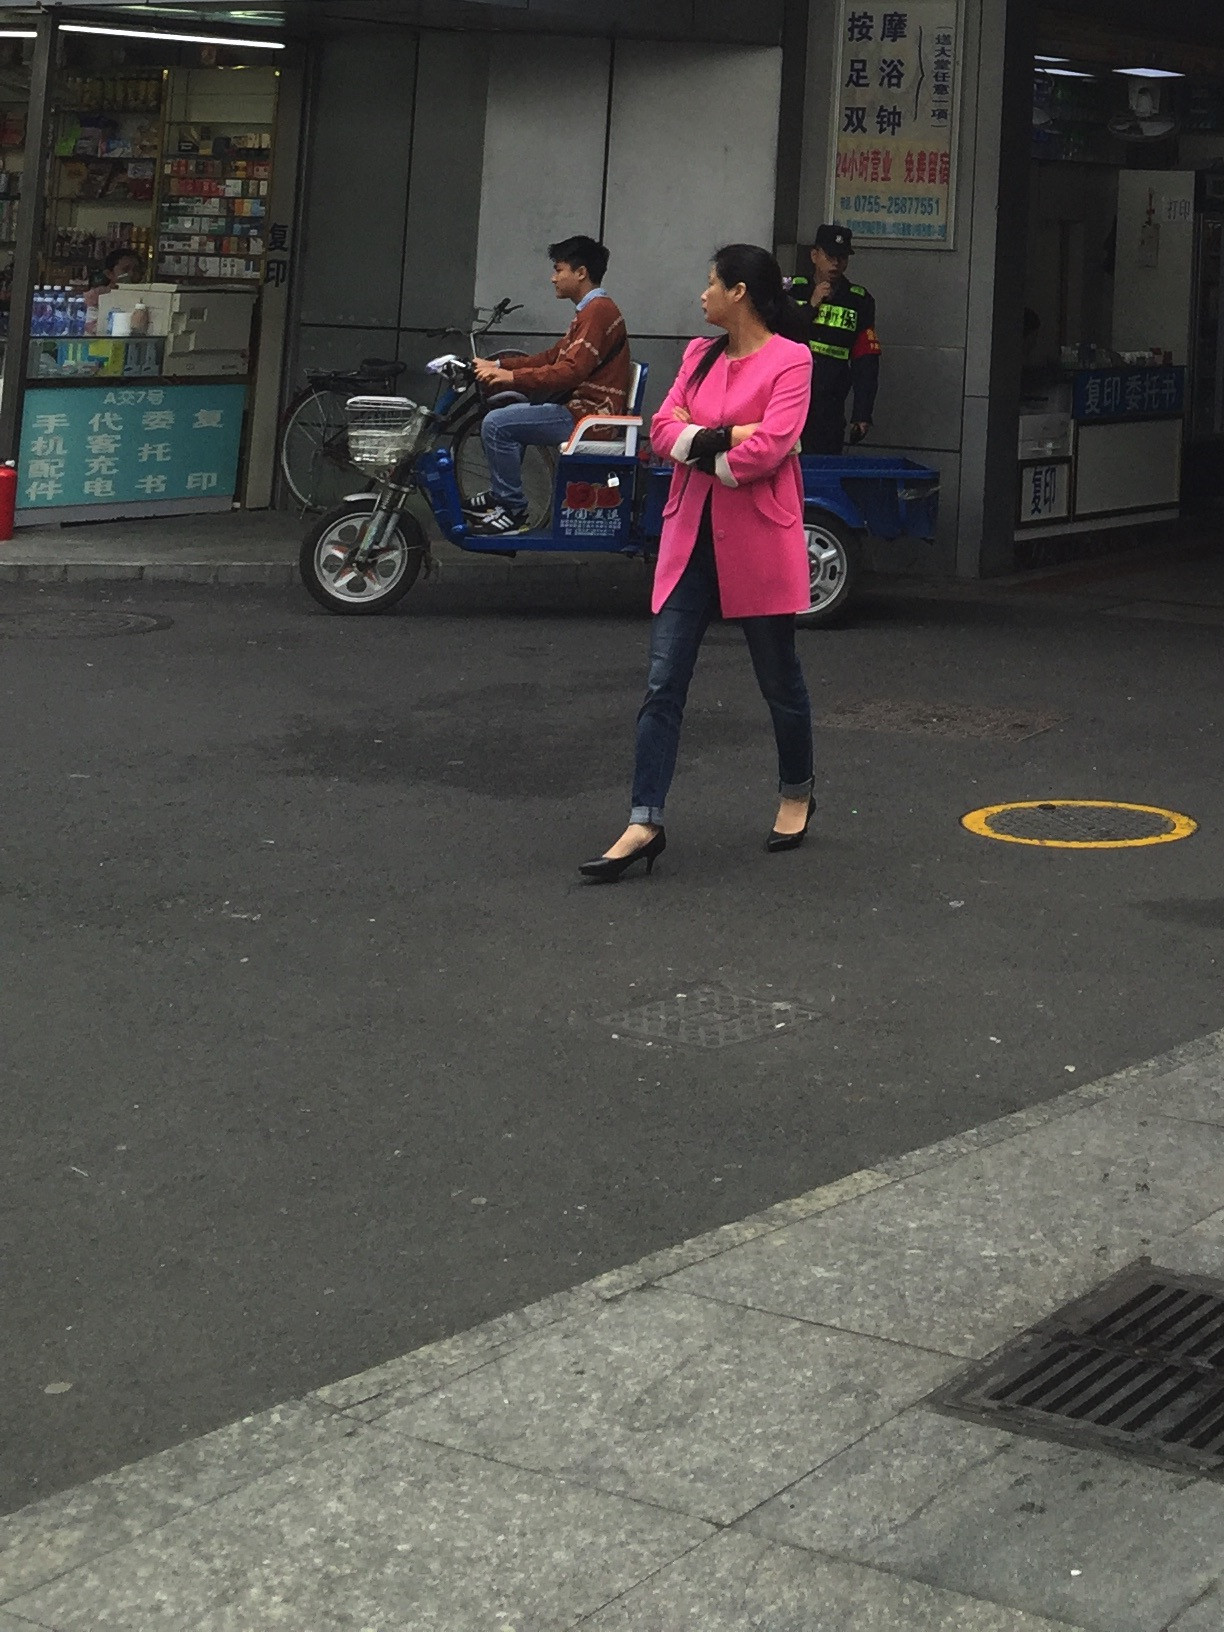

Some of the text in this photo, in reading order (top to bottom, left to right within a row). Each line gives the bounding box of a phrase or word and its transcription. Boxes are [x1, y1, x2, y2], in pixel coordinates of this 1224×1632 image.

[847, 11, 908, 43] 按摩
[845, 58, 905, 90] 足浴
[842, 104, 903, 136] 双钟
[853, 195, 940, 217] 0755-25877551
[264, 222, 288, 287] 复印
[103, 389, 165, 406] A交7号
[1085, 372, 1178, 415] 复印 委托书
[25, 413, 70, 501] 手机配件
[83, 411, 124, 497] 代客充电
[135, 409, 175, 494] 委托书
[186, 408, 224, 491] 复印
[1031, 464, 1057, 515] 复印
